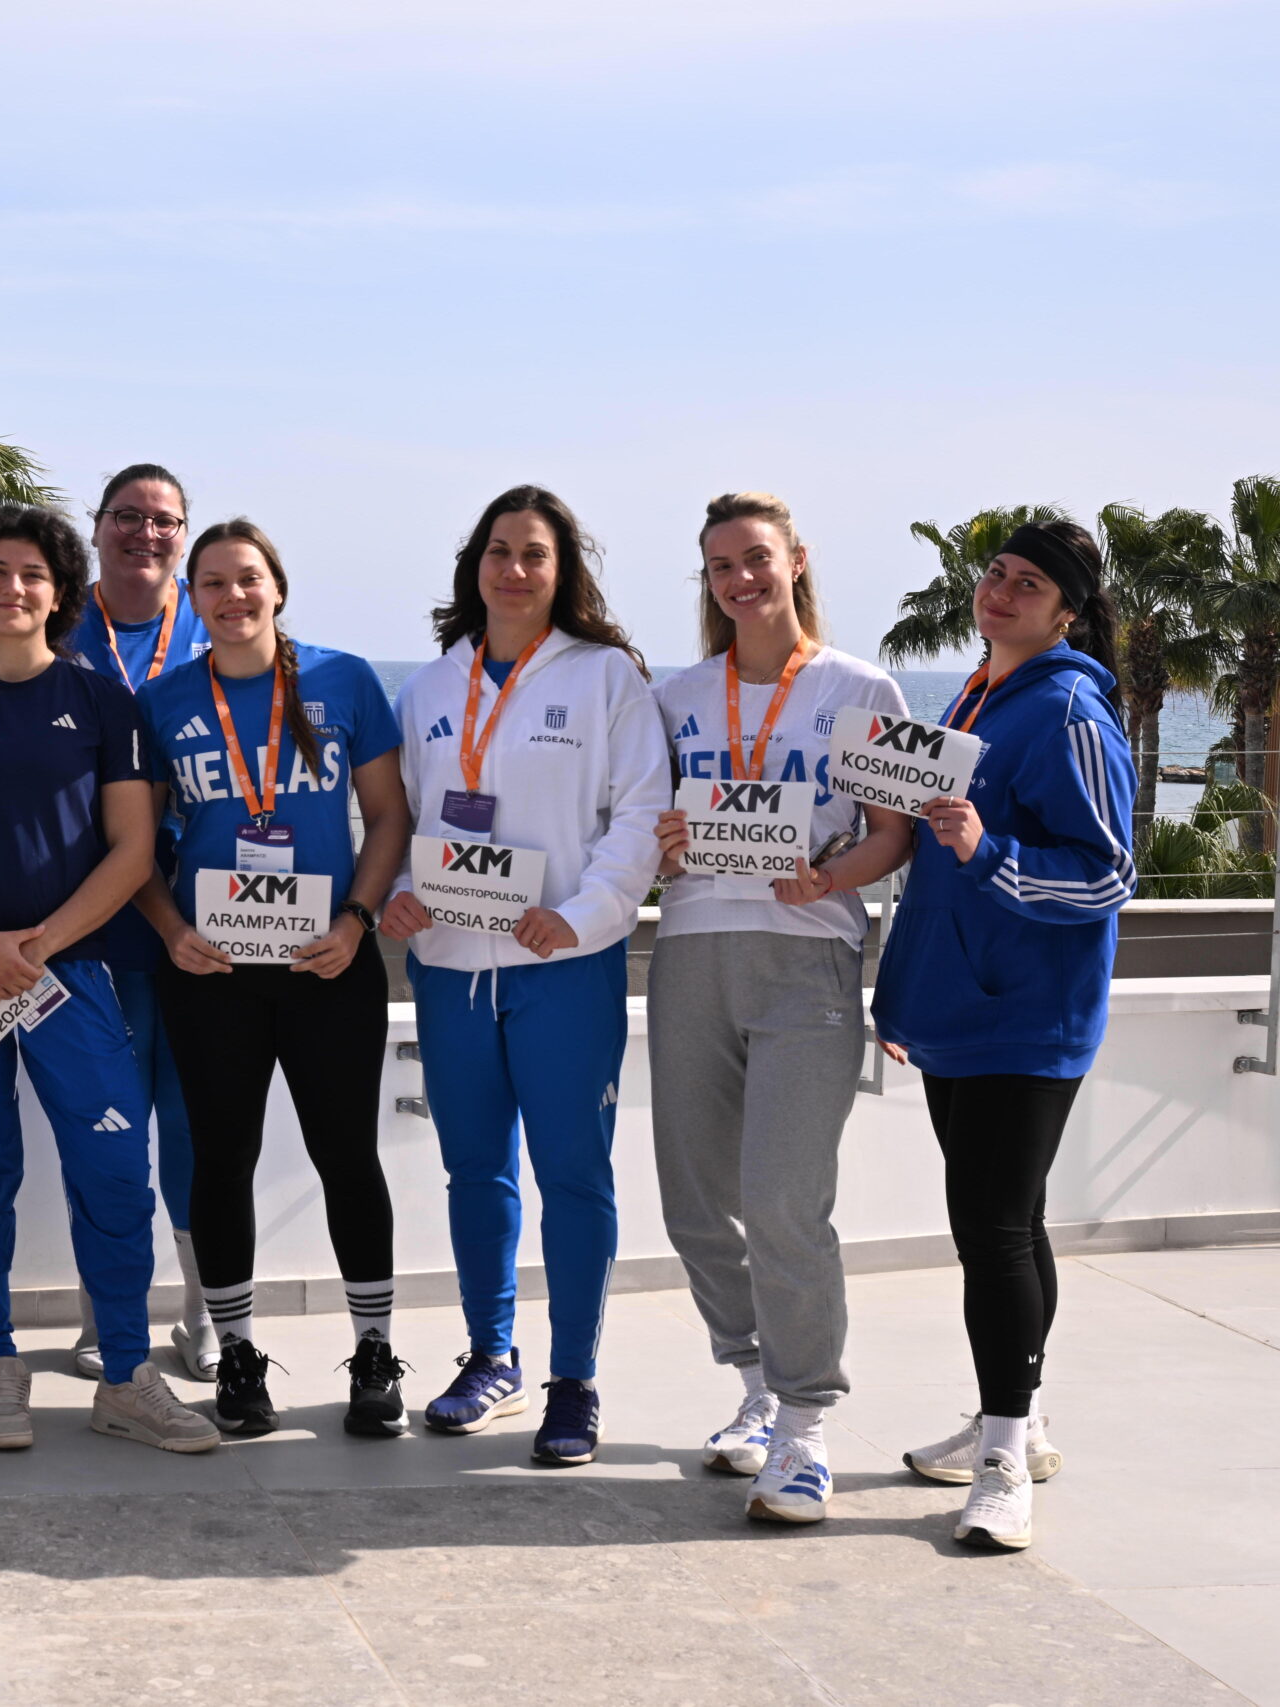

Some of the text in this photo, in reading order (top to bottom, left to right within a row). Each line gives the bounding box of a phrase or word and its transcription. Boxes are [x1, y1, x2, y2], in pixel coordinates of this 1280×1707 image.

[529, 735, 574, 745] AEGEAN
[874, 715, 946, 760] XM
[841, 750, 955, 792] KOSMIDOU
[716, 783, 782, 813] XM
[832, 776, 906, 810] NICOSIA
[688, 821, 797, 844] TZENGKO
[448, 842, 513, 878] XM
[684, 851, 796, 871] NICOSIA 202
[235, 873, 298, 905] XM
[421, 881, 528, 904] ANAGNOSTOPOULOU
[206, 912, 315, 933] ARAMPATZI
[424, 905, 484, 930] ICOSIA
